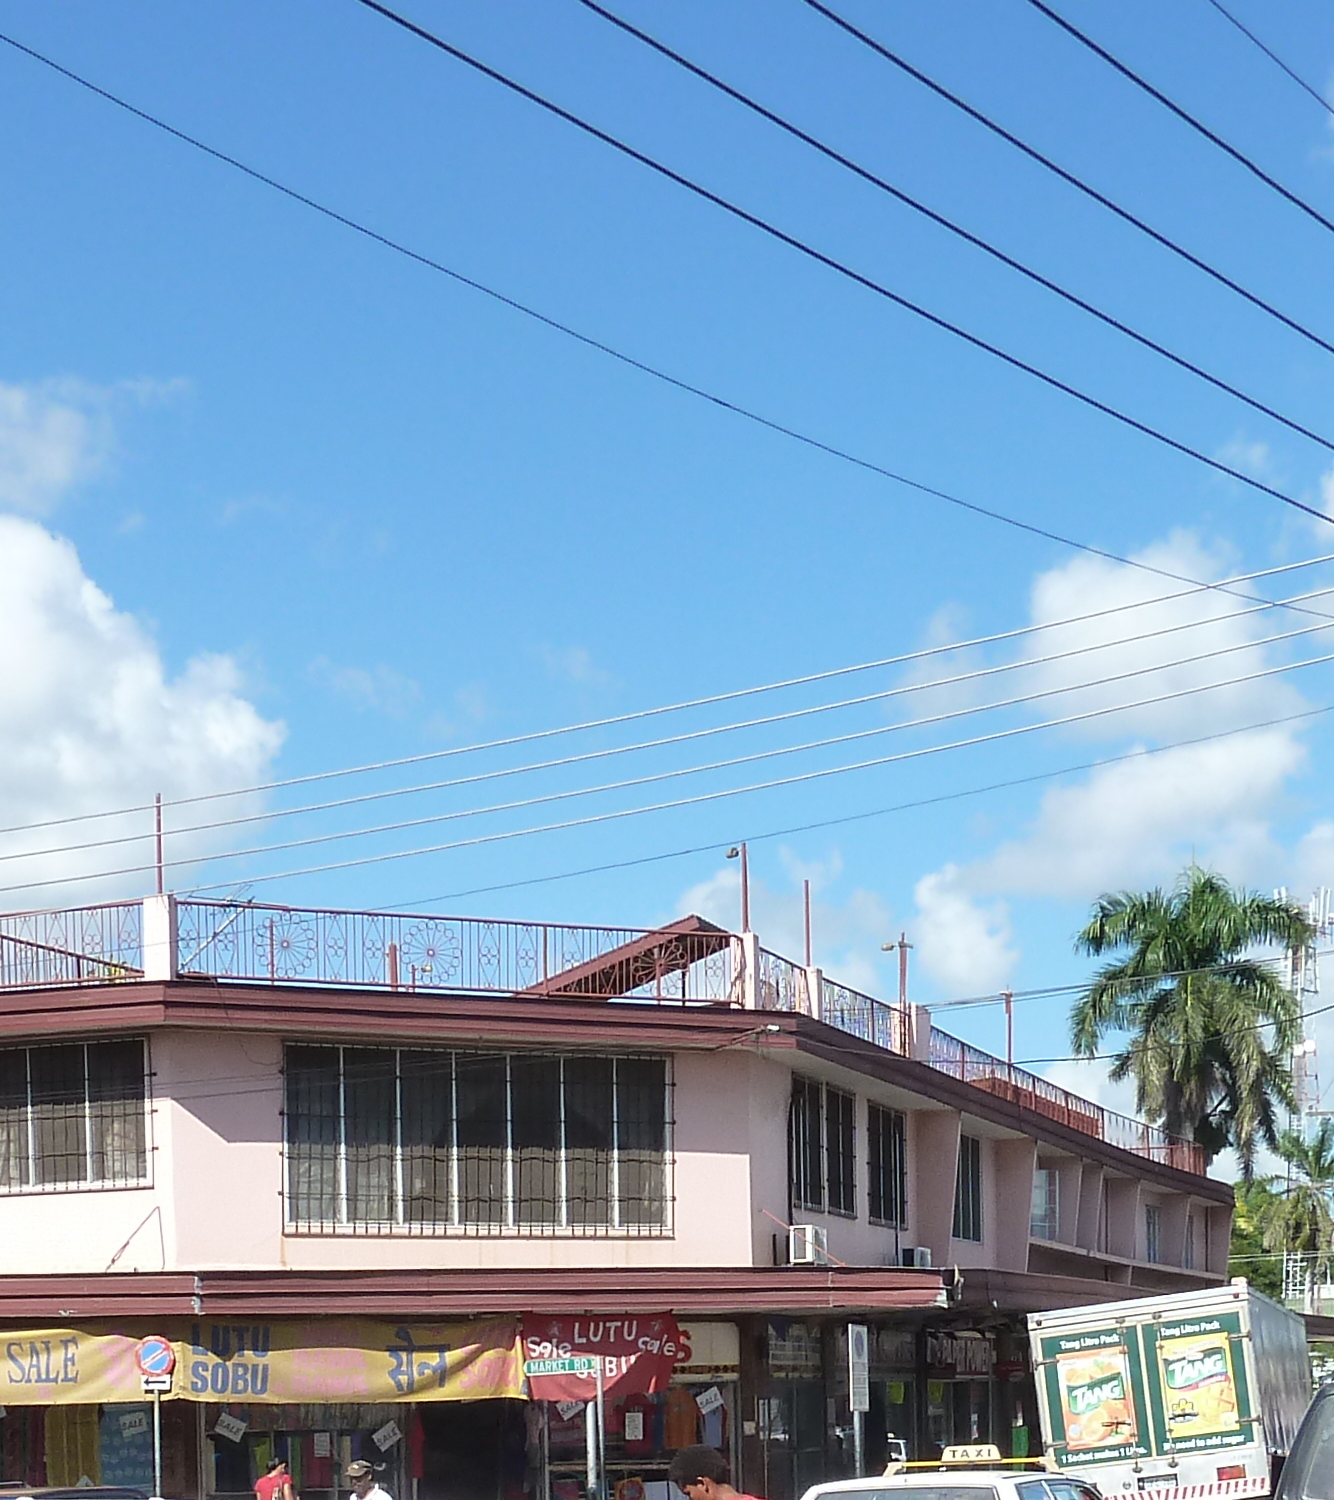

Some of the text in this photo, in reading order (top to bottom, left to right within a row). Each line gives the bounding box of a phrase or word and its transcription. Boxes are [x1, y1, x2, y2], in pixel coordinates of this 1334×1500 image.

[189, 1322, 272, 1359] LUTU
[573, 1320, 638, 1345] LUTU
[526, 1335, 572, 1359] Sale
[5, 1339, 80, 1386] SALE
[530, 1357, 589, 1373] MARKET RD
[1167, 1354, 1225, 1385] TANG
[189, 1360, 270, 1396] SOBU
[1071, 1379, 1121, 1412] TANG
[121, 1417, 145, 1431] SALE
[374, 1421, 400, 1445] SALE
[948, 1447, 995, 1460] TAXI
